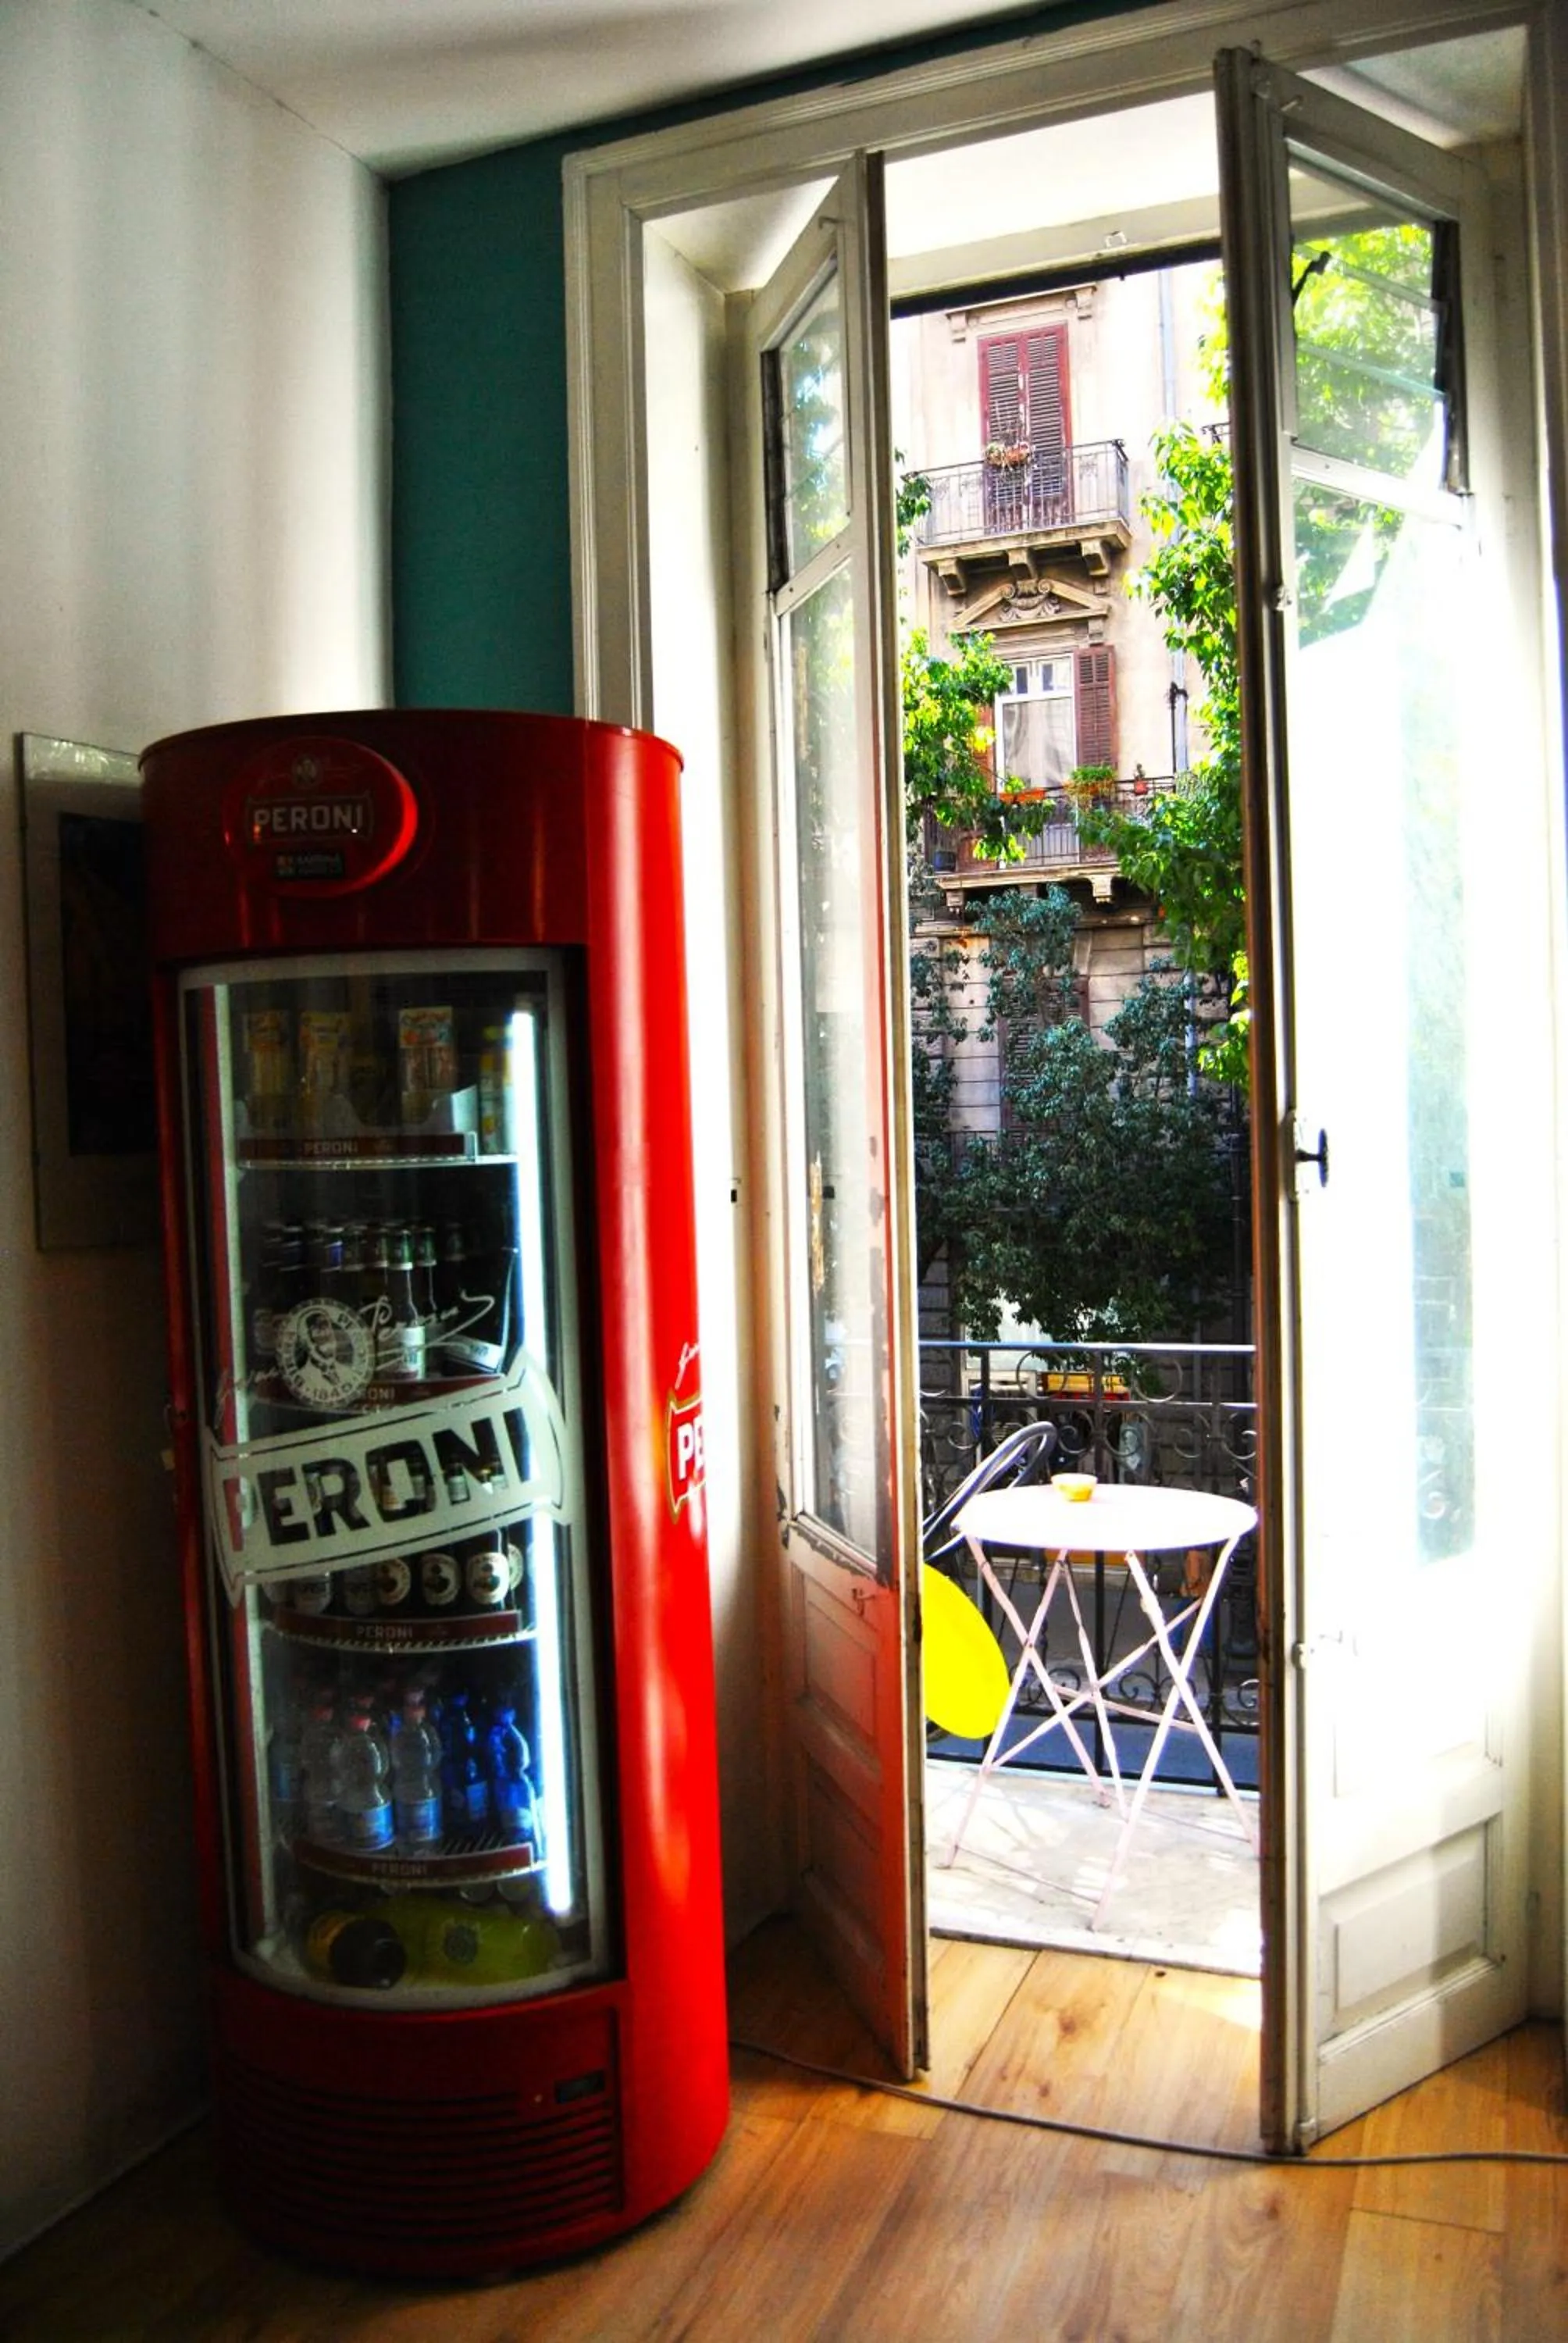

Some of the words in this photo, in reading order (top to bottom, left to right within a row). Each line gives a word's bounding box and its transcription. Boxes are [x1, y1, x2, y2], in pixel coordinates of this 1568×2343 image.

[254, 804, 363, 836] PERONI
[304, 1140, 358, 1155] PERONI
[223, 1407, 531, 1553] PERONI
[355, 1624, 413, 1639] PERONI
